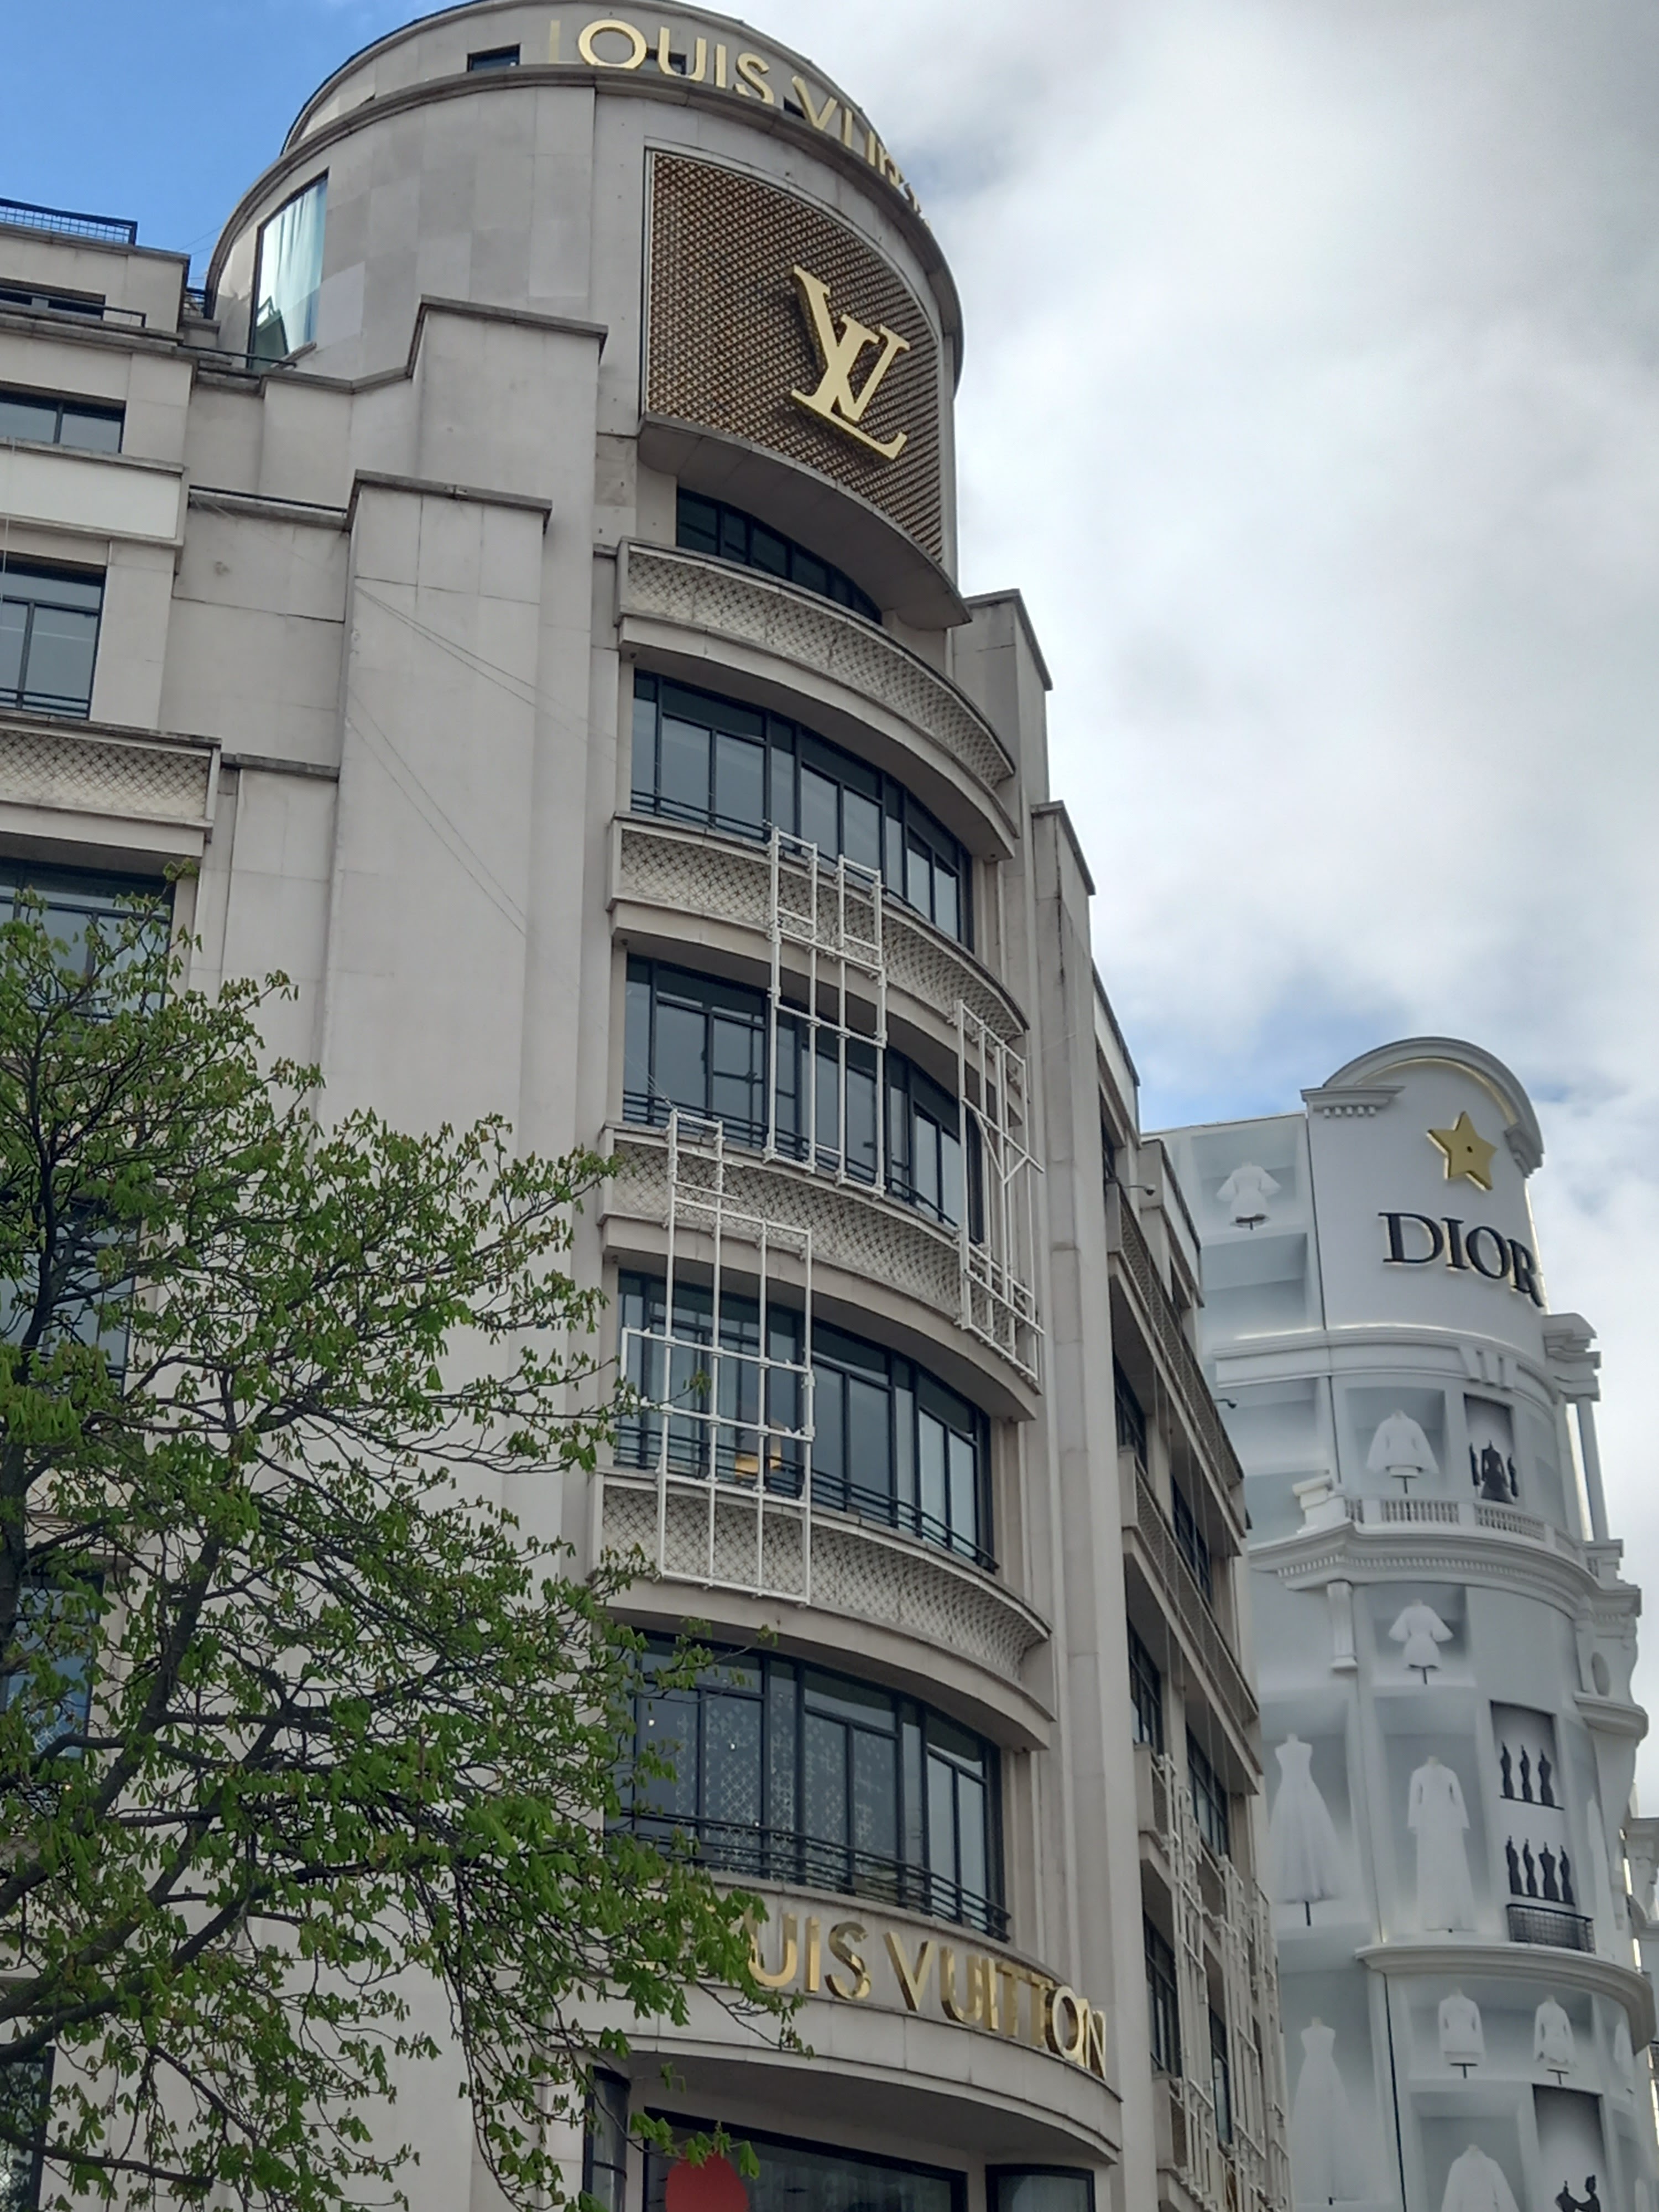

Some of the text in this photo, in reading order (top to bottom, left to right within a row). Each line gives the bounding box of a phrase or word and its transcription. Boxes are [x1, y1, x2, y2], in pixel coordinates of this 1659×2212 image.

[1378, 1212, 1544, 1307] DIOR
[677, 1903, 1105, 2081] UIS VUITTON
